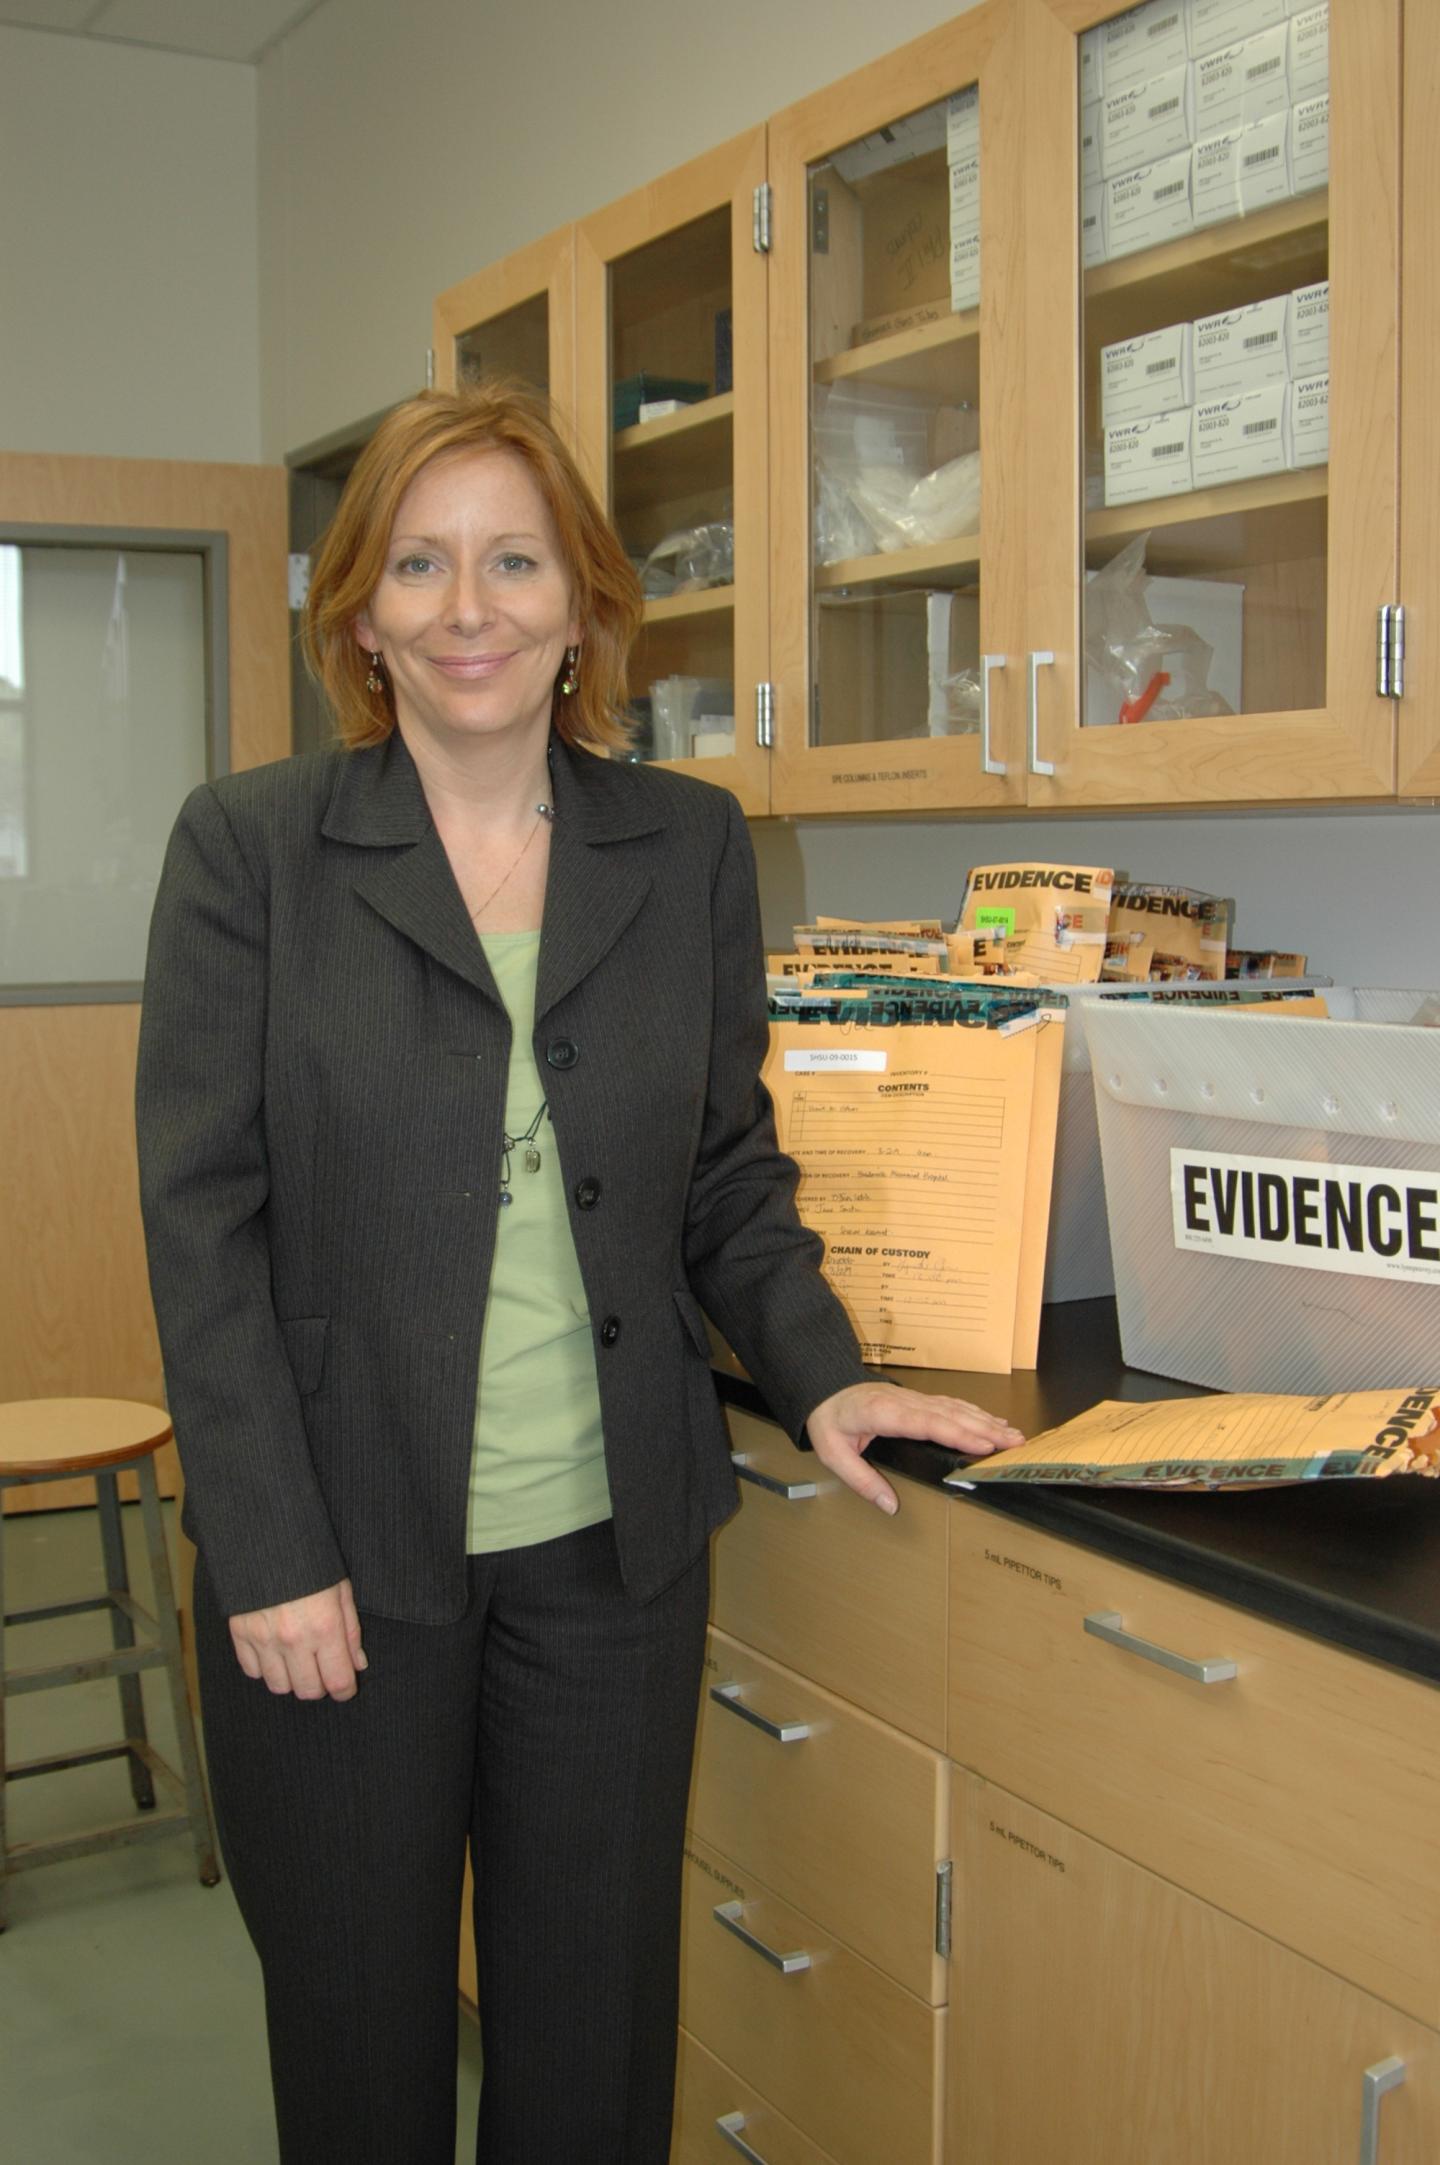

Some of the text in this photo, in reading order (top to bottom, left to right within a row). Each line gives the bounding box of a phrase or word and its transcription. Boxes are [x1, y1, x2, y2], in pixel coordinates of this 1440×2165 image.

[1297, 22, 1328, 42] 82003-82
[1200, 55, 1223, 71] VWR
[1106, 93, 1128, 109] VWR
[1298, 102, 1324, 116] VWR
[1298, 114, 1328, 133] 82003-82
[1197, 140, 1221, 154] VWR
[1111, 176, 1133, 190] VWR
[1297, 289, 1323, 304] VWR
[1198, 319, 1221, 333] VWR
[1105, 347, 1126, 360] VWR
[1298, 380, 1323, 393] VWR
[1198, 405, 1220, 417] VWR
[1109, 427, 1131, 439] VWR
[972, 870, 1092, 894] EVIDENCE
[878, 1083, 929, 1093] CONTENTS
[1184, 1164, 1440, 1262] EVIDENCE
[830, 1246, 931, 1259] CHAIN OF CUSTODY
[1144, 1463, 1286, 1479] EVIDENCE
[984, 1549, 990, 1560] 5
[1003, 1557, 1042, 1581] PIPETTOR
[1043, 1573, 1062, 1590] TIPS
[1008, 1831, 1046, 1861] PIPETTOR
[1047, 1854, 1065, 1872] TIPS
